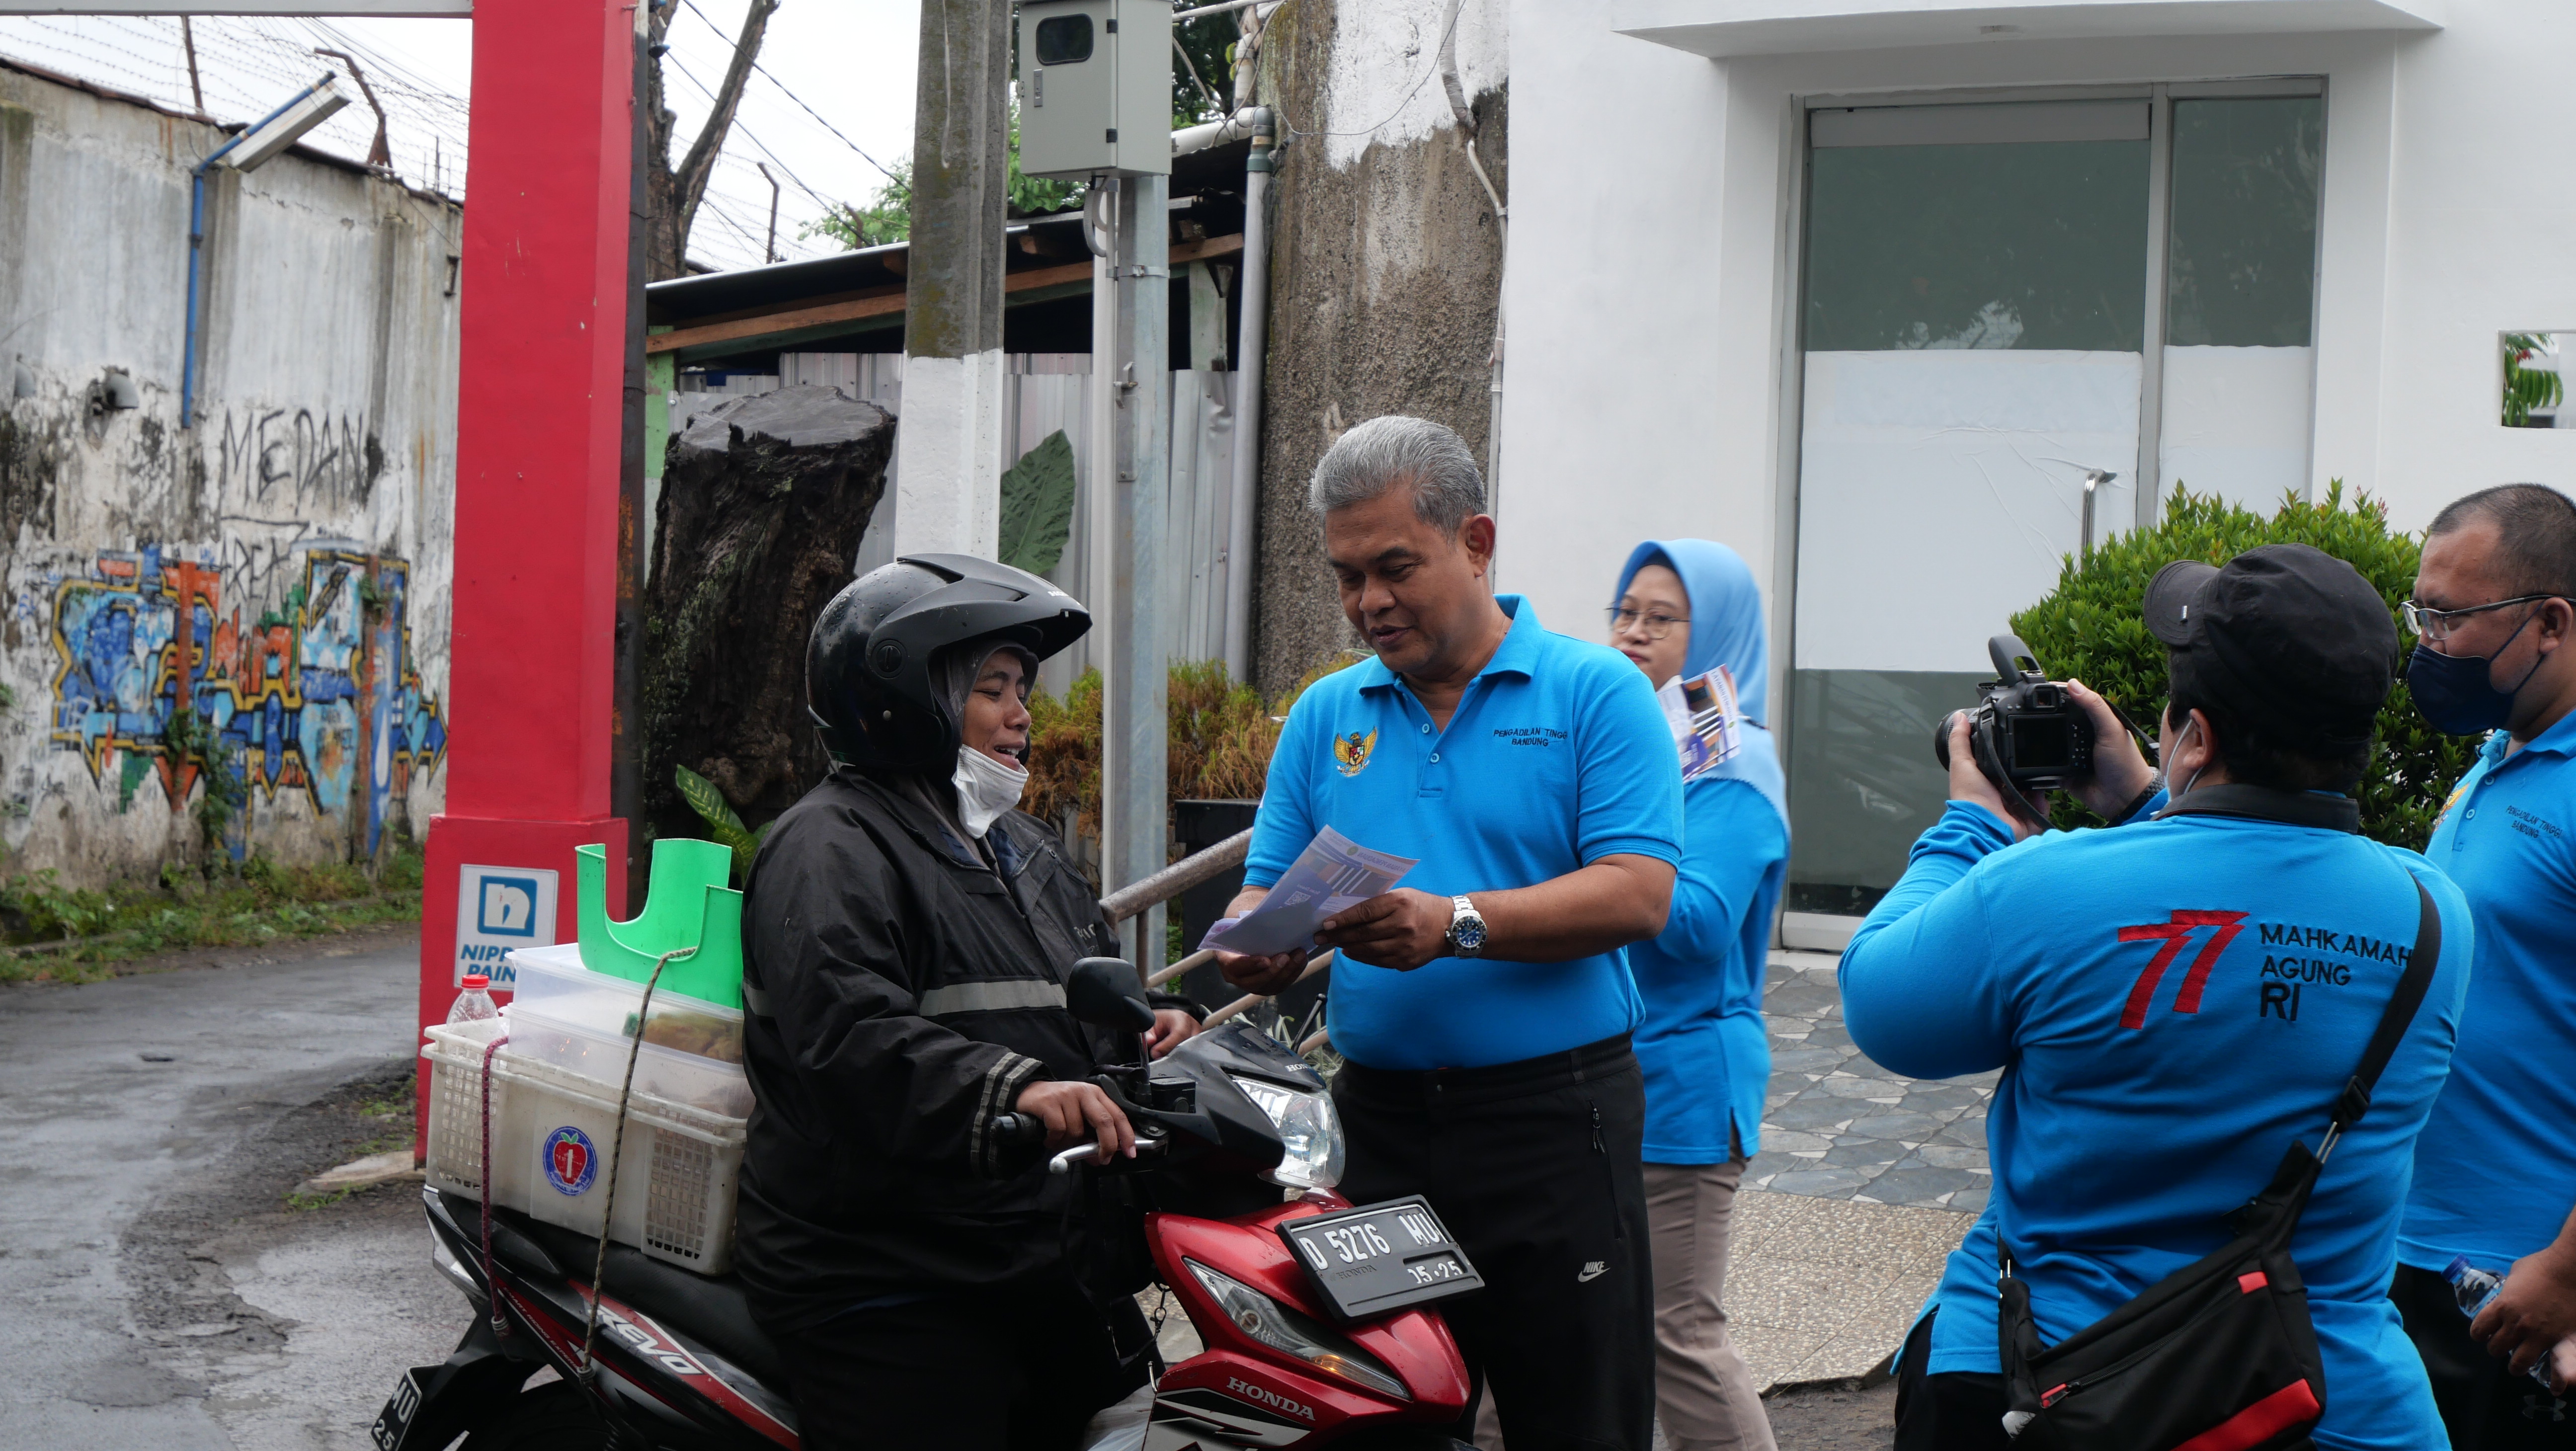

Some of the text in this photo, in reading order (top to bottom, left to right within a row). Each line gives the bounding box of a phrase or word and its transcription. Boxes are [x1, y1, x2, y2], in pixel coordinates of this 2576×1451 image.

[220, 407, 366, 514] MEDAN
[1493, 727, 1540, 737] PENGADILAN
[1512, 737, 1548, 746] BANDUNG
[2505, 805, 2563, 838] PENGADILAN TINGGI
[2511, 820, 2539, 838] BANDUNG
[461, 944, 514, 962] NIPP
[2259, 923, 2413, 967] MAHKAMAH
[467, 964, 516, 981] PAIN
[2118, 909, 2250, 1030] 77
[2259, 955, 2351, 986] AGUNG
[2259, 981, 2300, 1021] RI
[1285, 1063, 1312, 1072] HON
[1299, 1236, 1328, 1270] D
[1324, 1222, 1391, 1263] 5276
[1336, 1265, 1377, 1279] HONDA
[1583, 1261, 1605, 1273] NIKE
[503, 1287, 579, 1370] SMART RIDING EXPERI
[587, 1303, 704, 1374] REVO
[1226, 1376, 1316, 1421] HONDA
